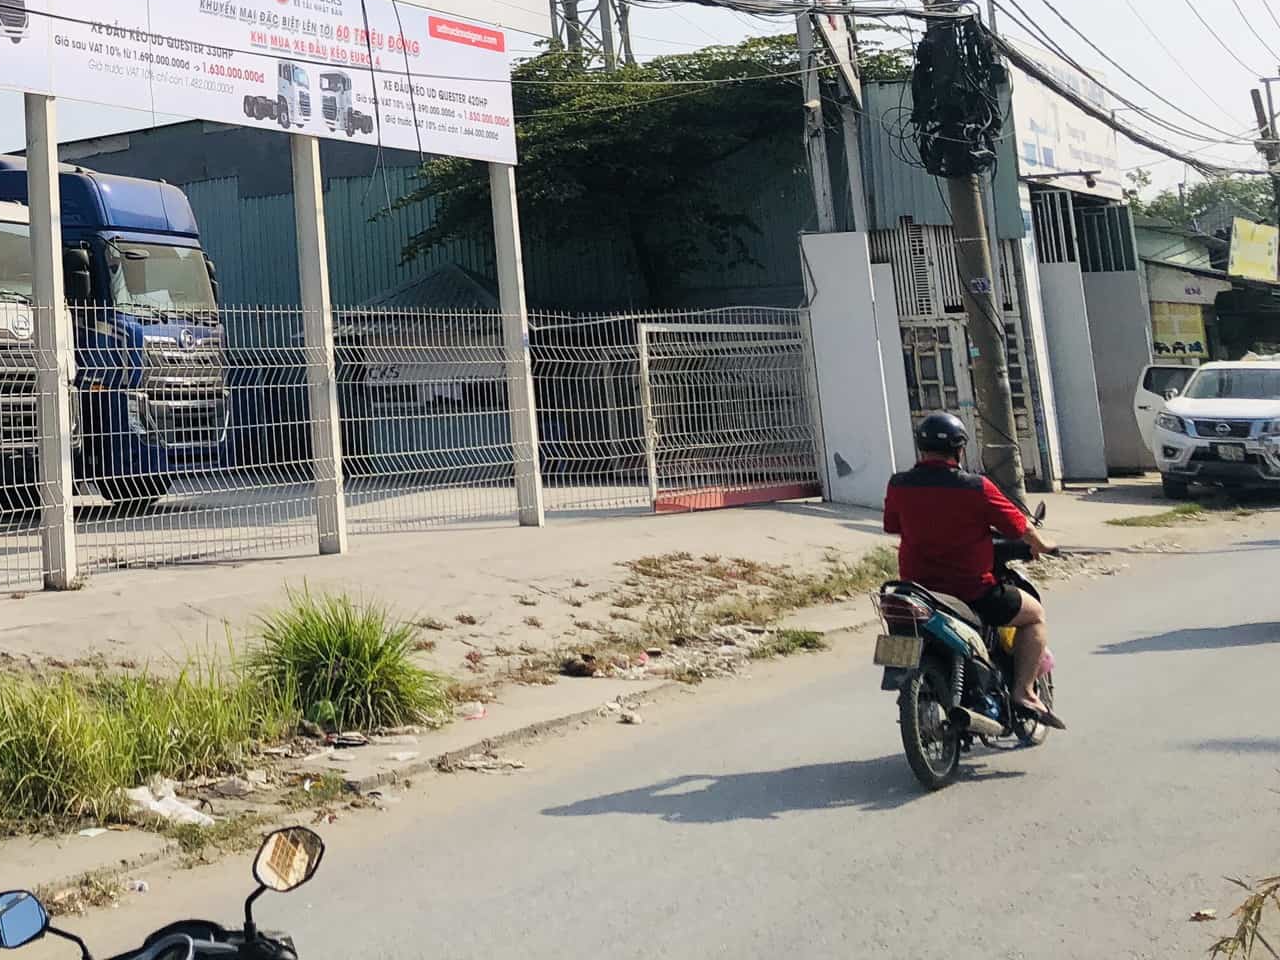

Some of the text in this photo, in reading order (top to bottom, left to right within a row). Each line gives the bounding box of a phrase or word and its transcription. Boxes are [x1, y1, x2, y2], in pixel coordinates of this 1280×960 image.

[250, 30, 268, 46] KHI
[270, 34, 291, 50] MUA
[294, 39, 306, 53] XE
[336, 24, 350, 41] 60
[54, 33, 70, 48] Giá
[71, 39, 87, 51] sau
[89, 41, 103, 54] VAT
[105, 44, 122, 58] 10%
[167, 36, 204, 56] QUESTER
[383, 79, 393, 91] XE
